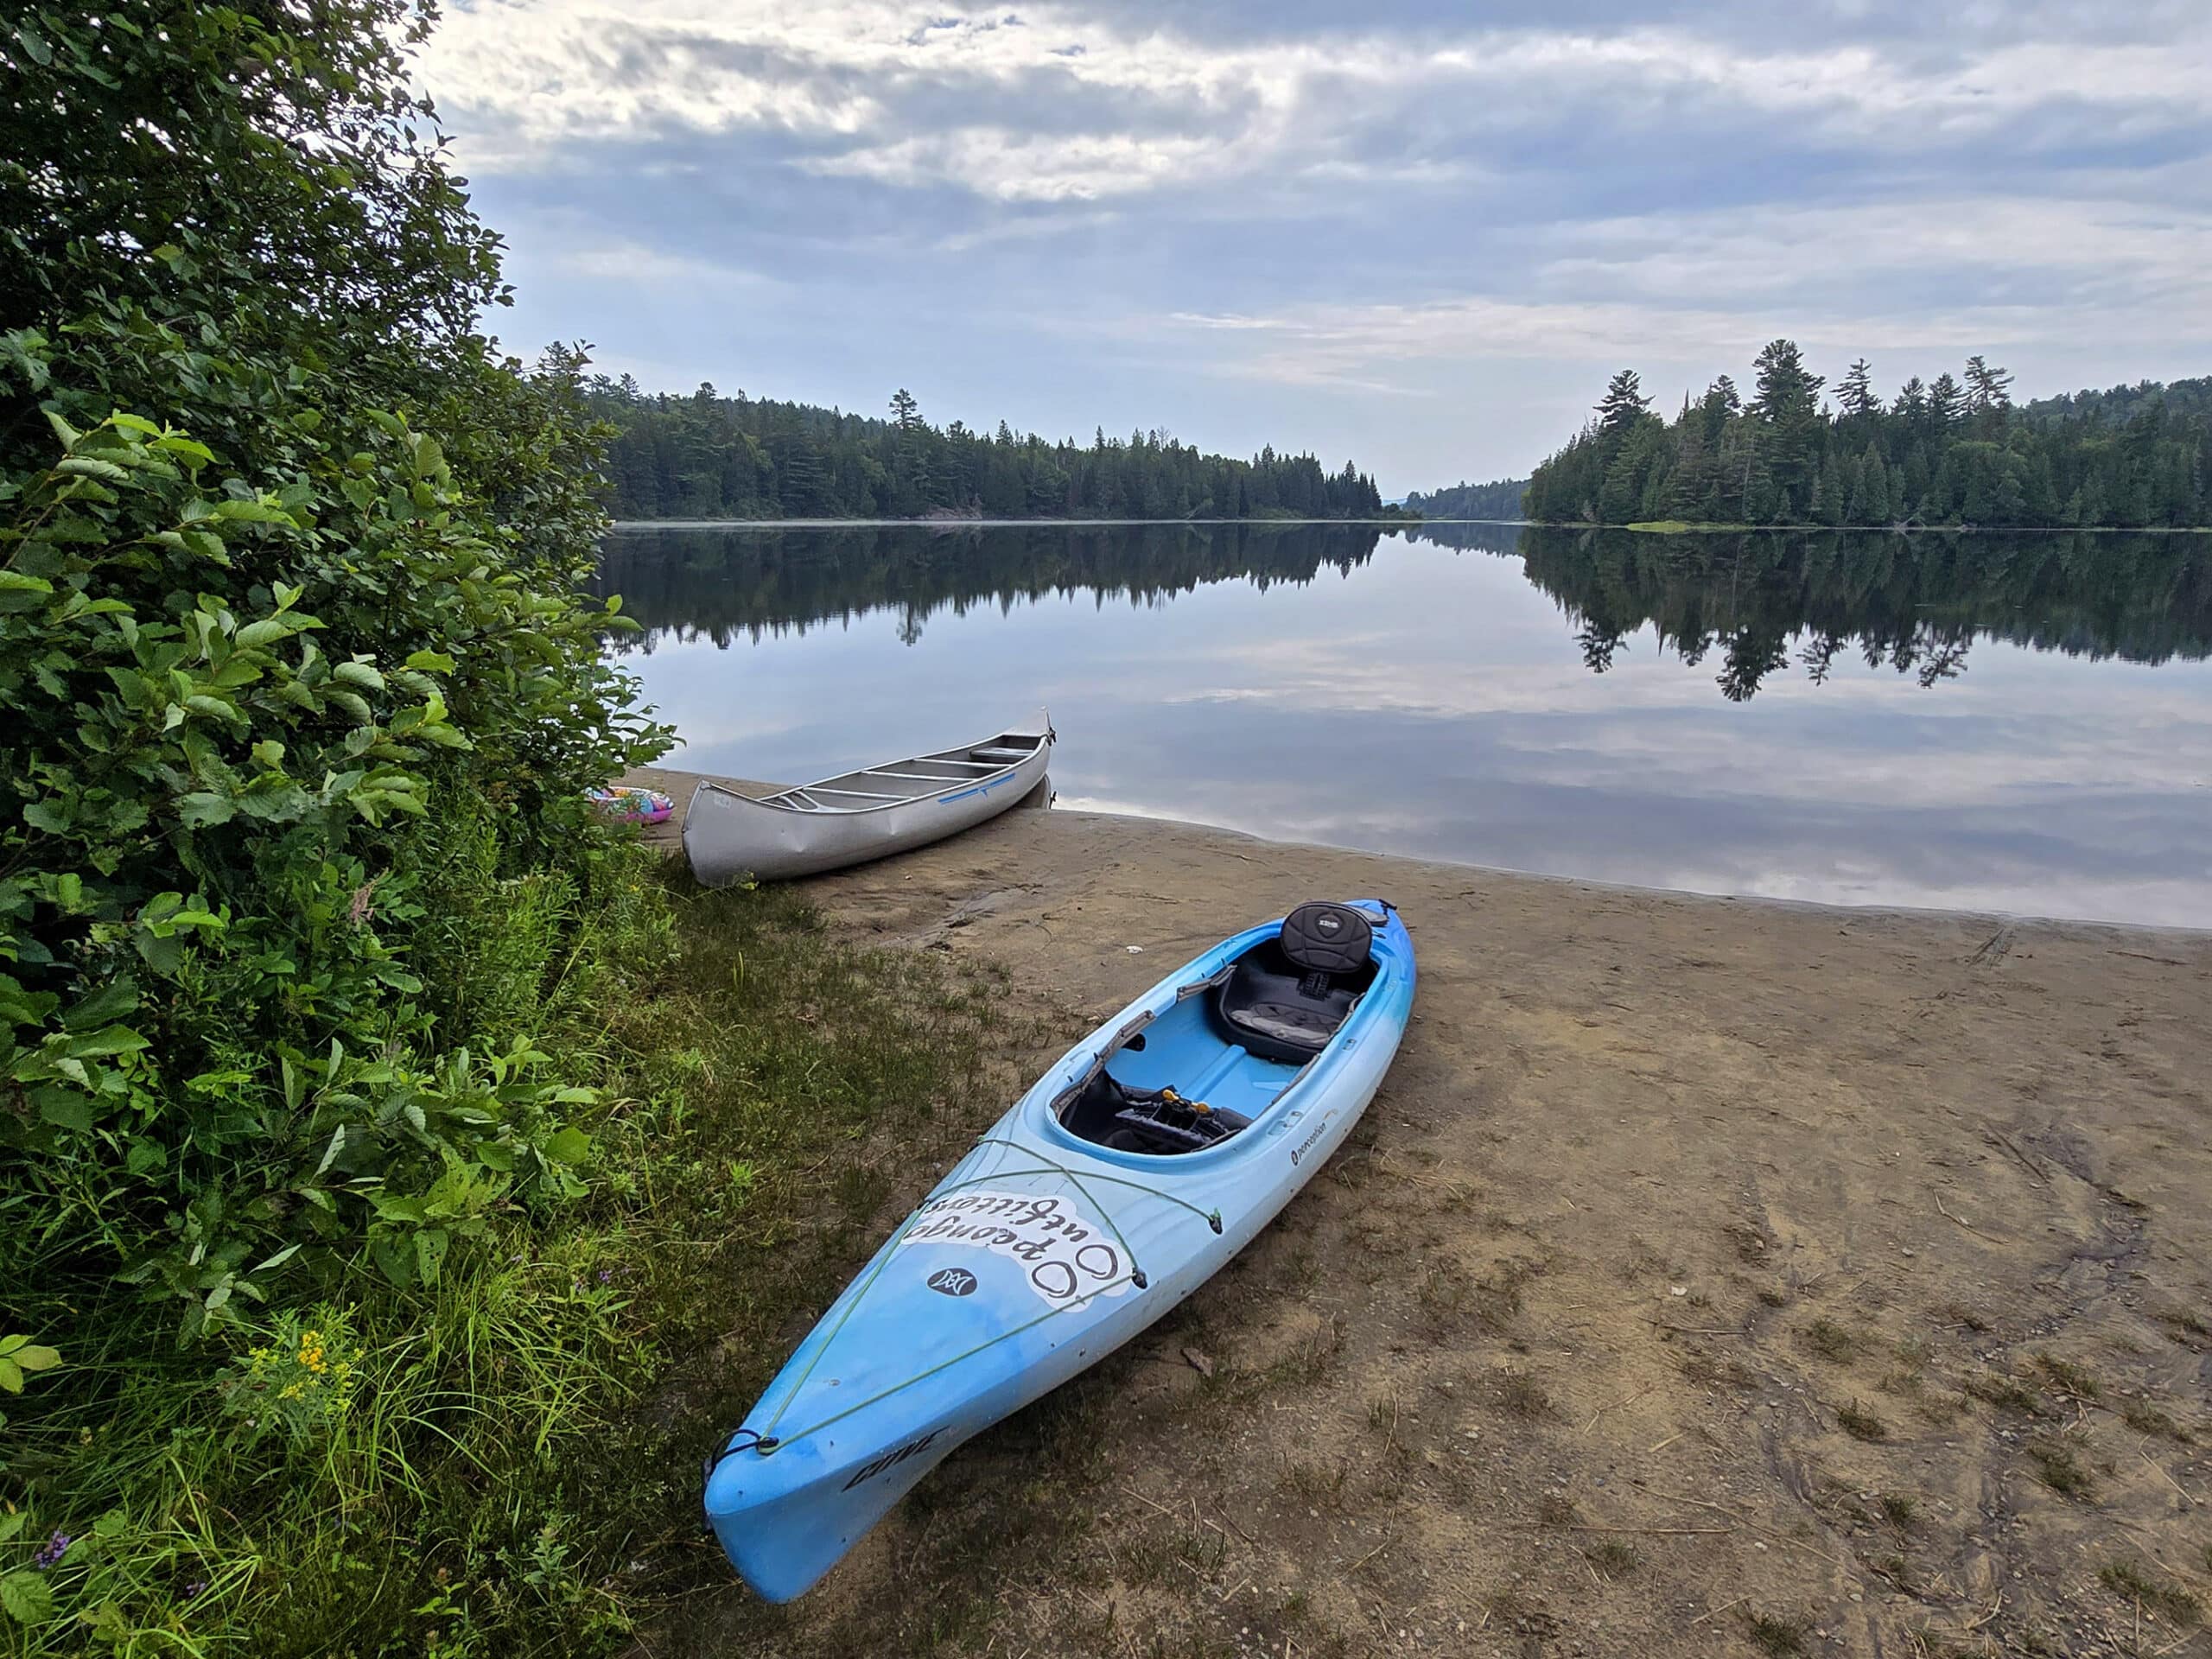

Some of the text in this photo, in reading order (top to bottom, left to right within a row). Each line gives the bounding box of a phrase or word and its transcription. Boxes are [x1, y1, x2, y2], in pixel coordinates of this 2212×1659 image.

[1298, 1122, 1327, 1160] perception
[904, 1215, 1077, 1298] Opeongo
[925, 1195, 1118, 1281] Outfitters
